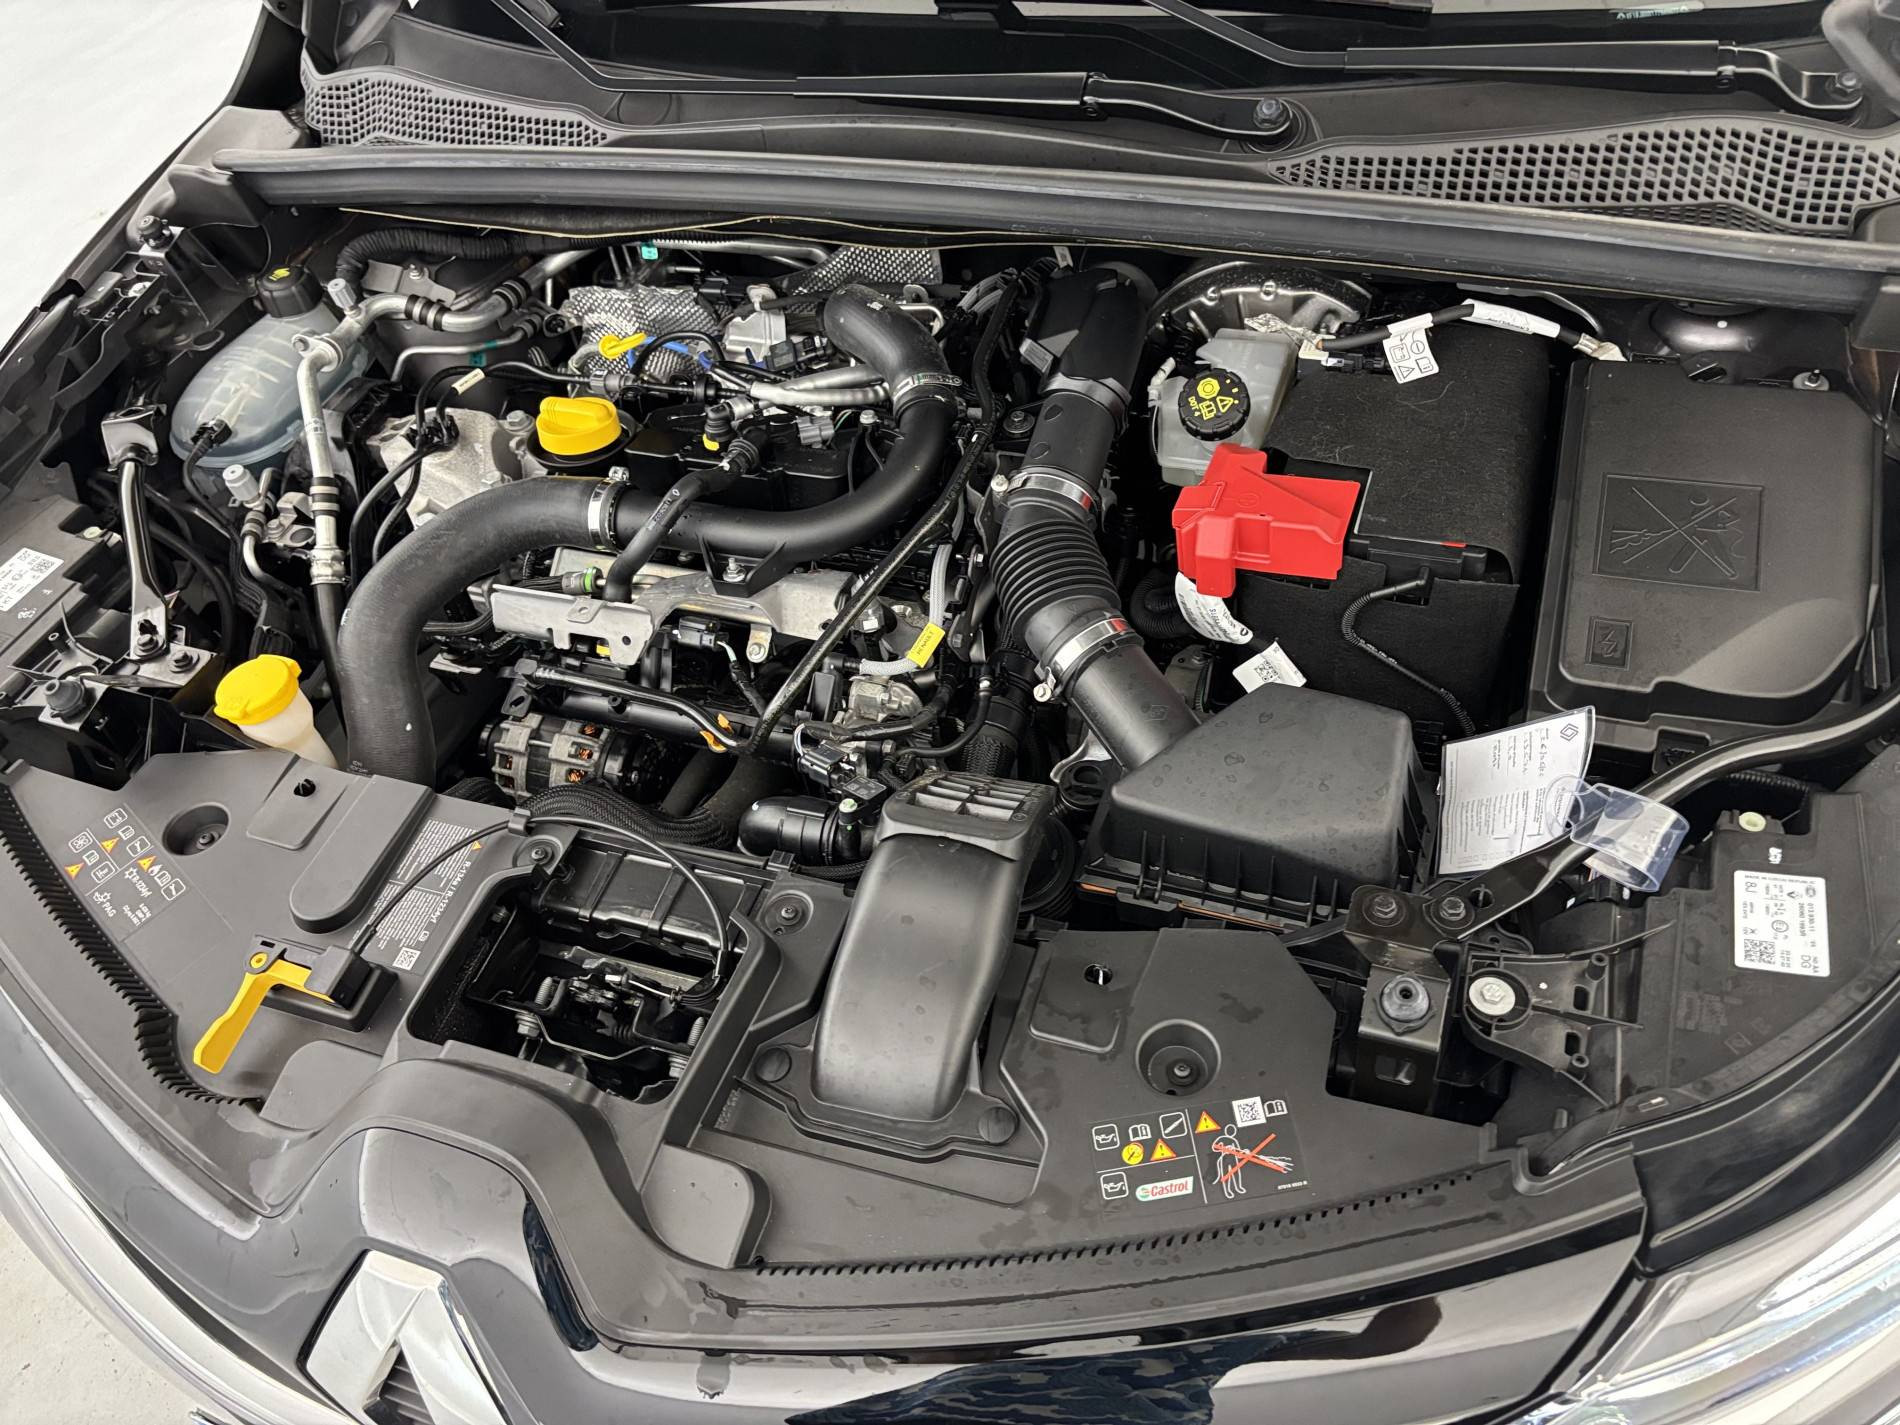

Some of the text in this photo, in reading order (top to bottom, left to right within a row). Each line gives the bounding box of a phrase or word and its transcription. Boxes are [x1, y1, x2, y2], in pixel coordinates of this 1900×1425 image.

[1188, 396, 1199, 410] DOT
[452, 861, 471, 885] R-134a
[131, 875, 152, 898] R-1234yf
[1745, 881, 1757, 893] 8J
[102, 902, 117, 917] PAG
[430, 890, 454, 924] R-1234yf
[1800, 954, 1812, 969] DG
[1151, 1179, 1189, 1197] Castrol
